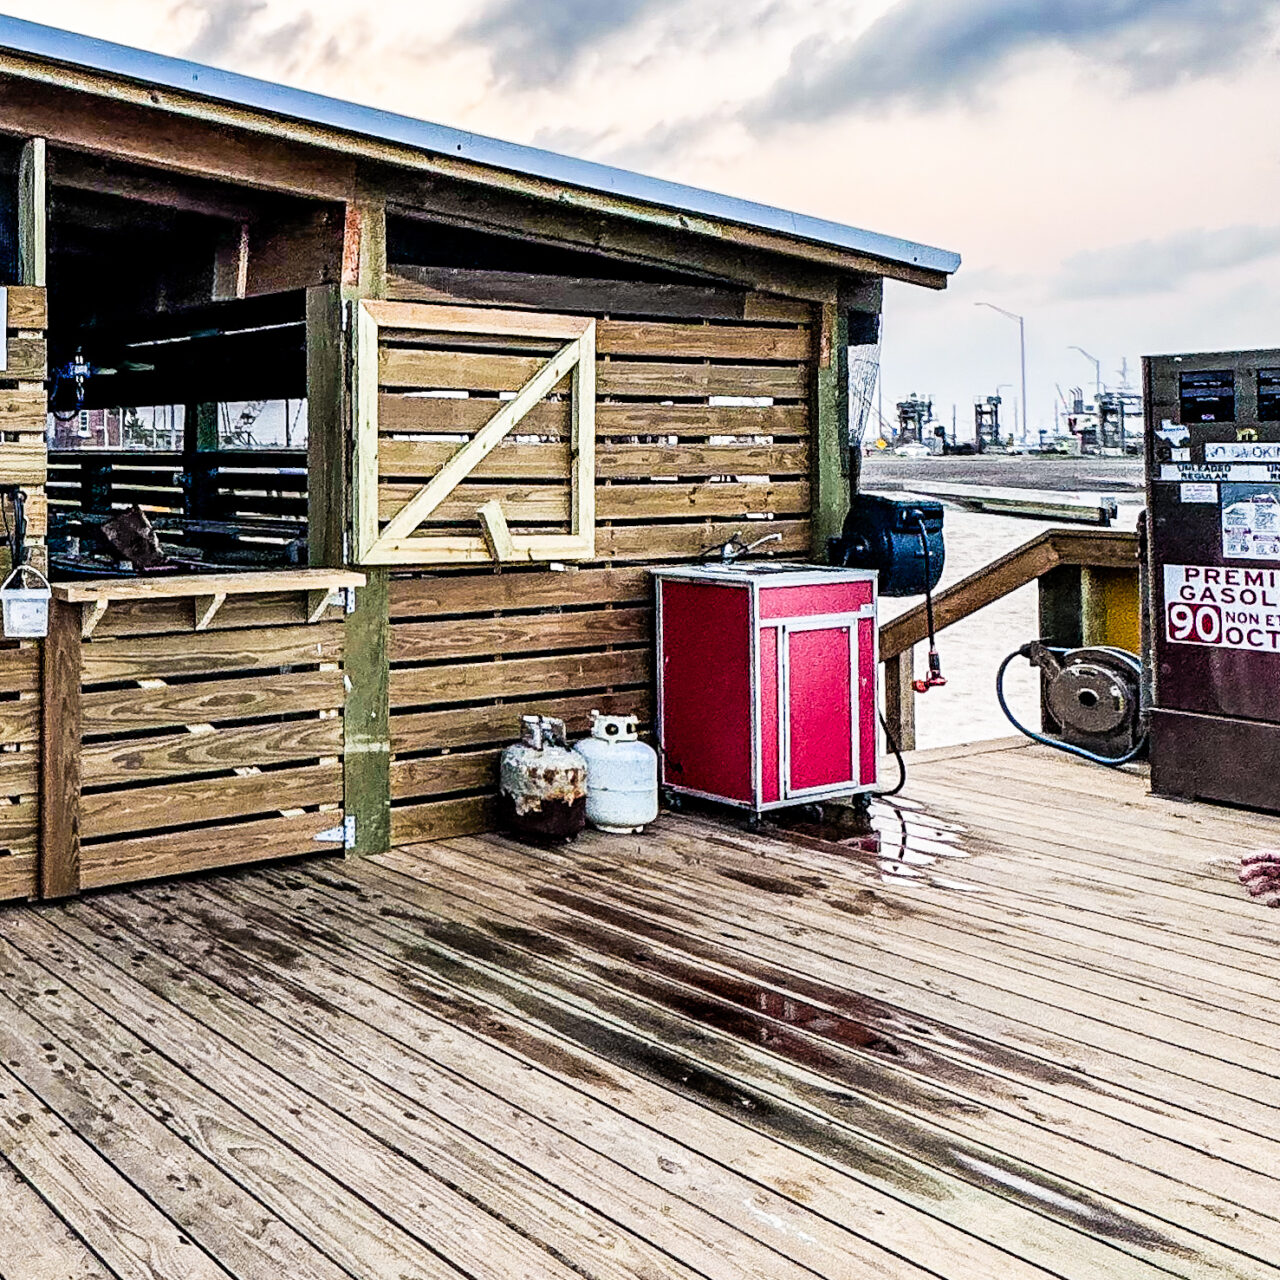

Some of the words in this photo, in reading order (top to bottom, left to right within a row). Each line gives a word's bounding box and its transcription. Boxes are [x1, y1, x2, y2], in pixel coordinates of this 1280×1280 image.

[1177, 463, 1232, 473] UNLEADED
[1180, 472, 1228, 480] REGULAR
[1184, 567, 1275, 588] PREMI
[1180, 585, 1277, 607] GASOL
[1170, 604, 1220, 643] 90
[1225, 611, 1260, 625] NON
[1225, 626, 1280, 649] OCT
